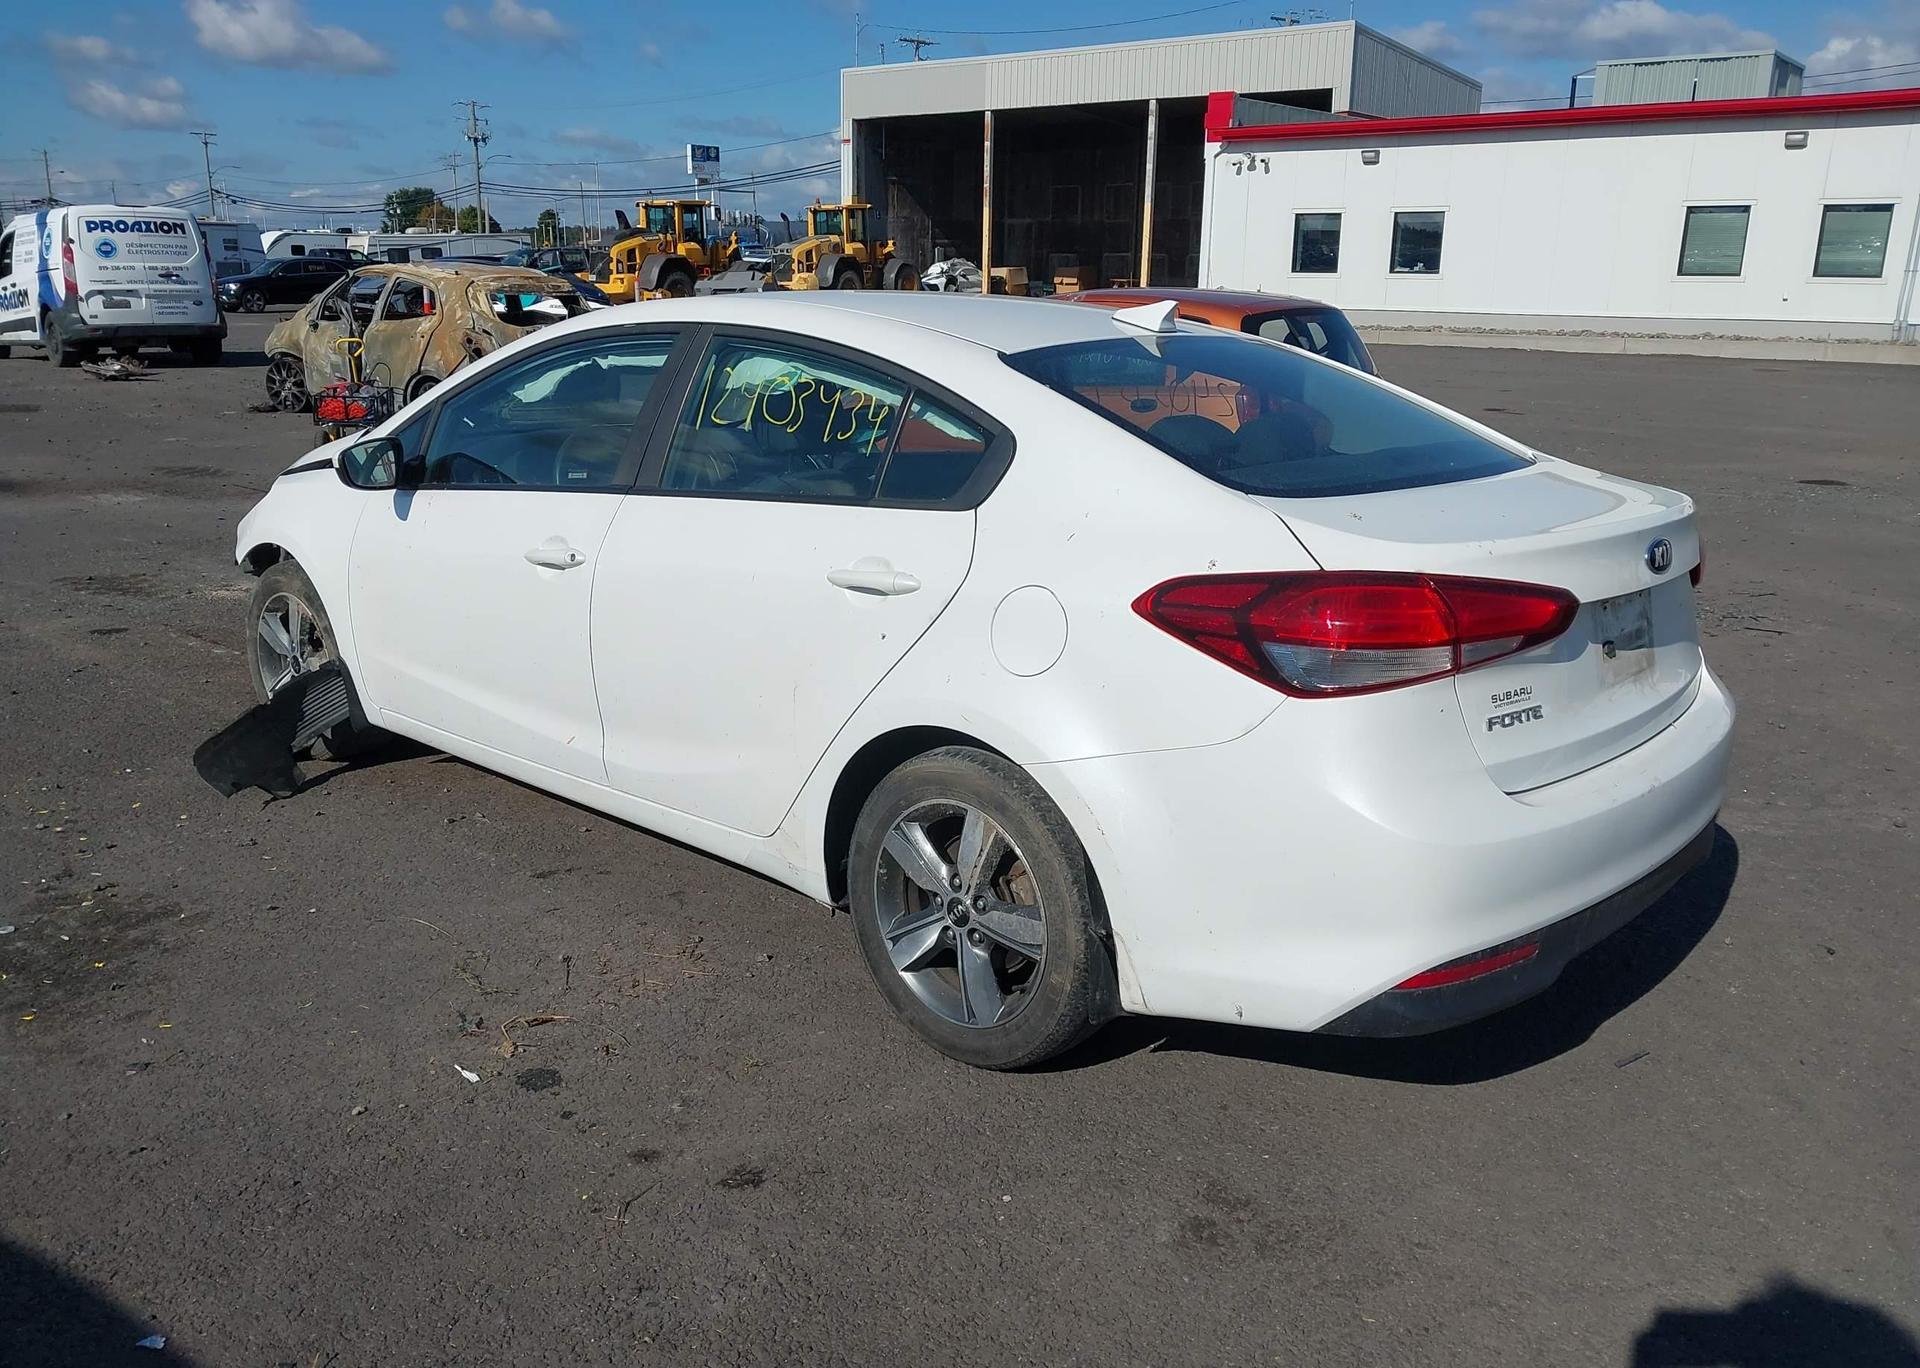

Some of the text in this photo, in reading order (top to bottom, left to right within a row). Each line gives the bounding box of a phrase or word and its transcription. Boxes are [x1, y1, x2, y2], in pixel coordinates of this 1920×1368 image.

[85, 219, 187, 235] PROAXION
[1491, 684, 1533, 704] SUBARU
[1493, 696, 1531, 709] VICTORIAVILLE
[1486, 704, 1544, 732] FORTE
